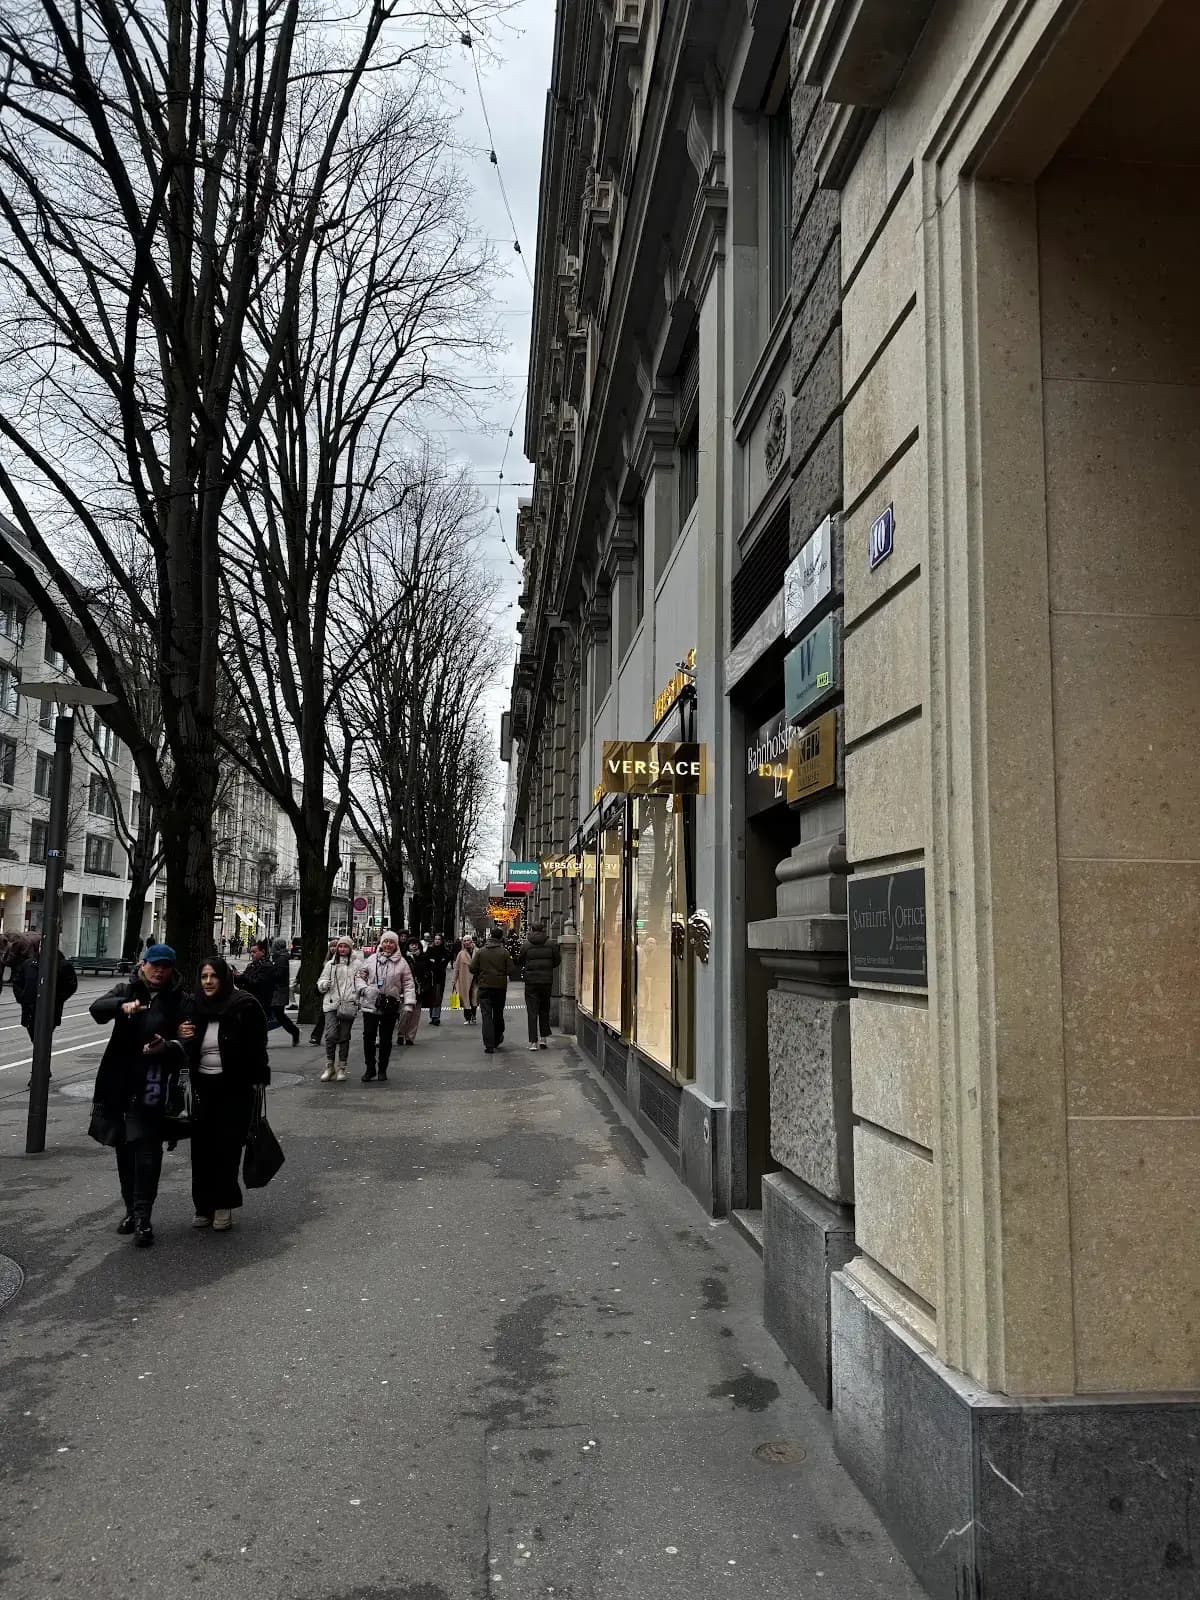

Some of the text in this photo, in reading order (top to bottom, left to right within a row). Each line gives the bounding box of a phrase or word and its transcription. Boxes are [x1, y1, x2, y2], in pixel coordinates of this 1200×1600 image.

[874, 519, 886, 559] 10
[747, 720, 802, 775] Bahnhofstra
[608, 759, 701, 776] VERSACE
[773, 763, 783, 799] 12
[894, 905, 925, 929] OFFICE
